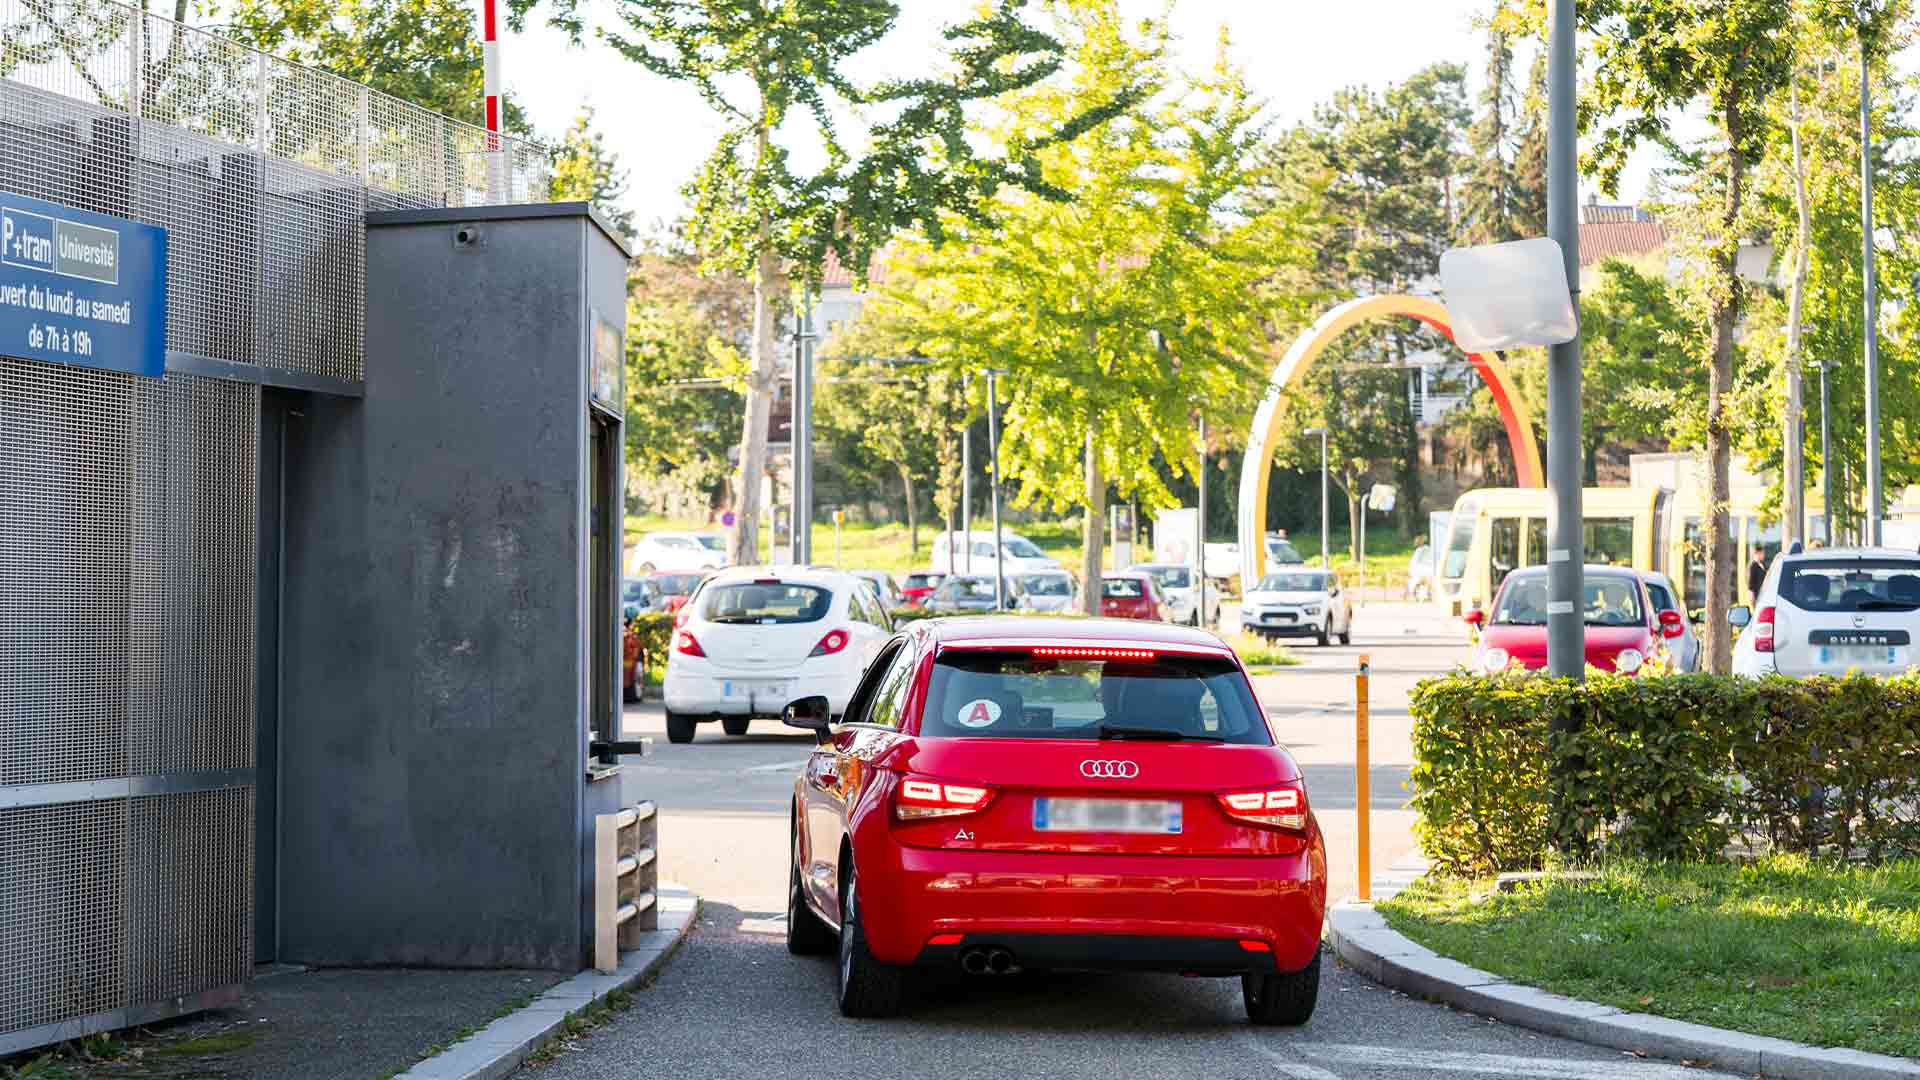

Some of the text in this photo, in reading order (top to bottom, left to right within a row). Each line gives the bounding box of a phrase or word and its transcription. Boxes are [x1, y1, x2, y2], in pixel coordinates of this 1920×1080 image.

[59, 235, 114, 267] Université
[29, 285, 44, 310] du
[46, 288, 73, 315] lundi
[75, 298, 90, 317] au
[92, 301, 131, 324] samedi
[28, 323, 92, 355] de 7h à 19h
[1830, 636, 1887, 644] DUSTER
[969, 703, 990, 721] A
[955, 829, 975, 840] A1
